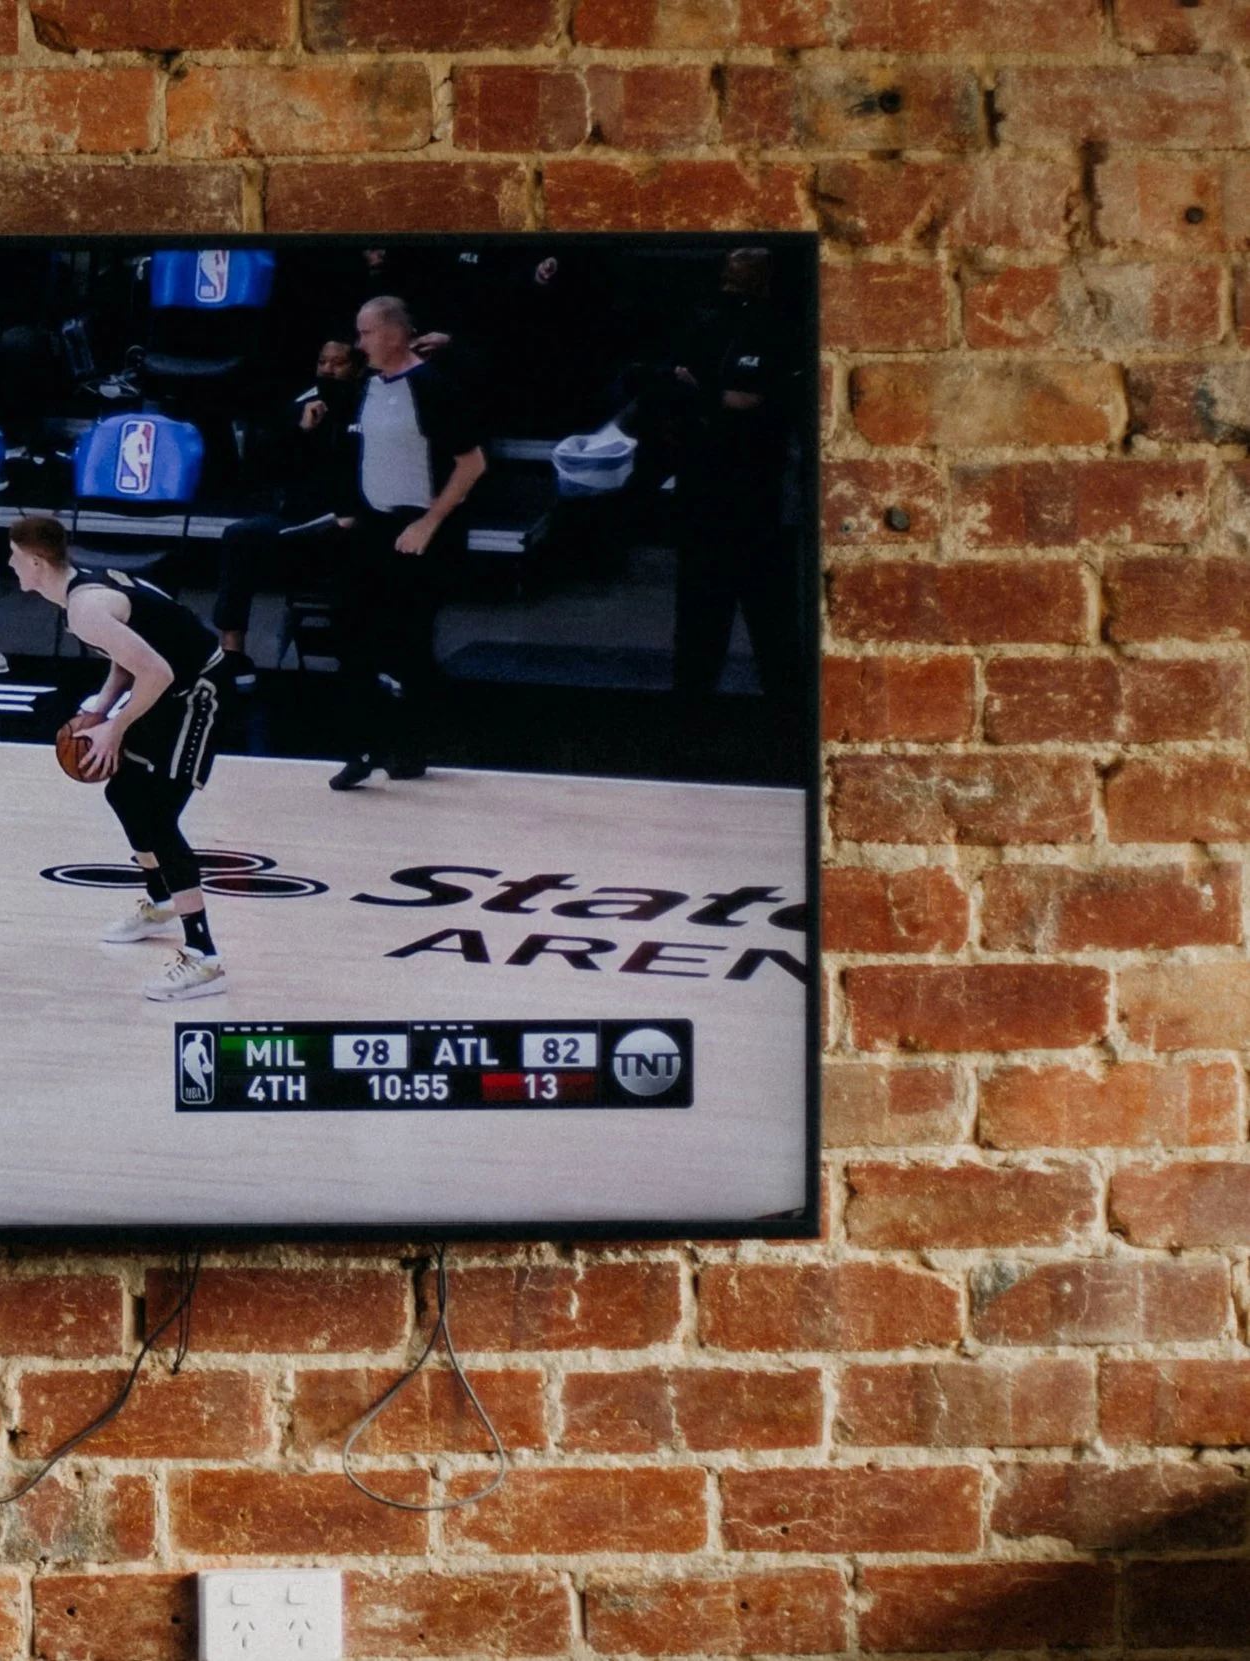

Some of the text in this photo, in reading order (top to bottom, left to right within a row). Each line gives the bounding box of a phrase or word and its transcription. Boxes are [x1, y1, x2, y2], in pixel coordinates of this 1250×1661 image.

[246, 1039, 306, 1067] MIL
[352, 1038, 390, 1067] 98
[434, 1037, 499, 1066] ATL
[542, 1037, 580, 1065] 82
[614, 1052, 679, 1078] TNT
[247, 1074, 306, 1101] 4TH
[368, 1073, 449, 1101] 10:55
[524, 1073, 558, 1100] 13
